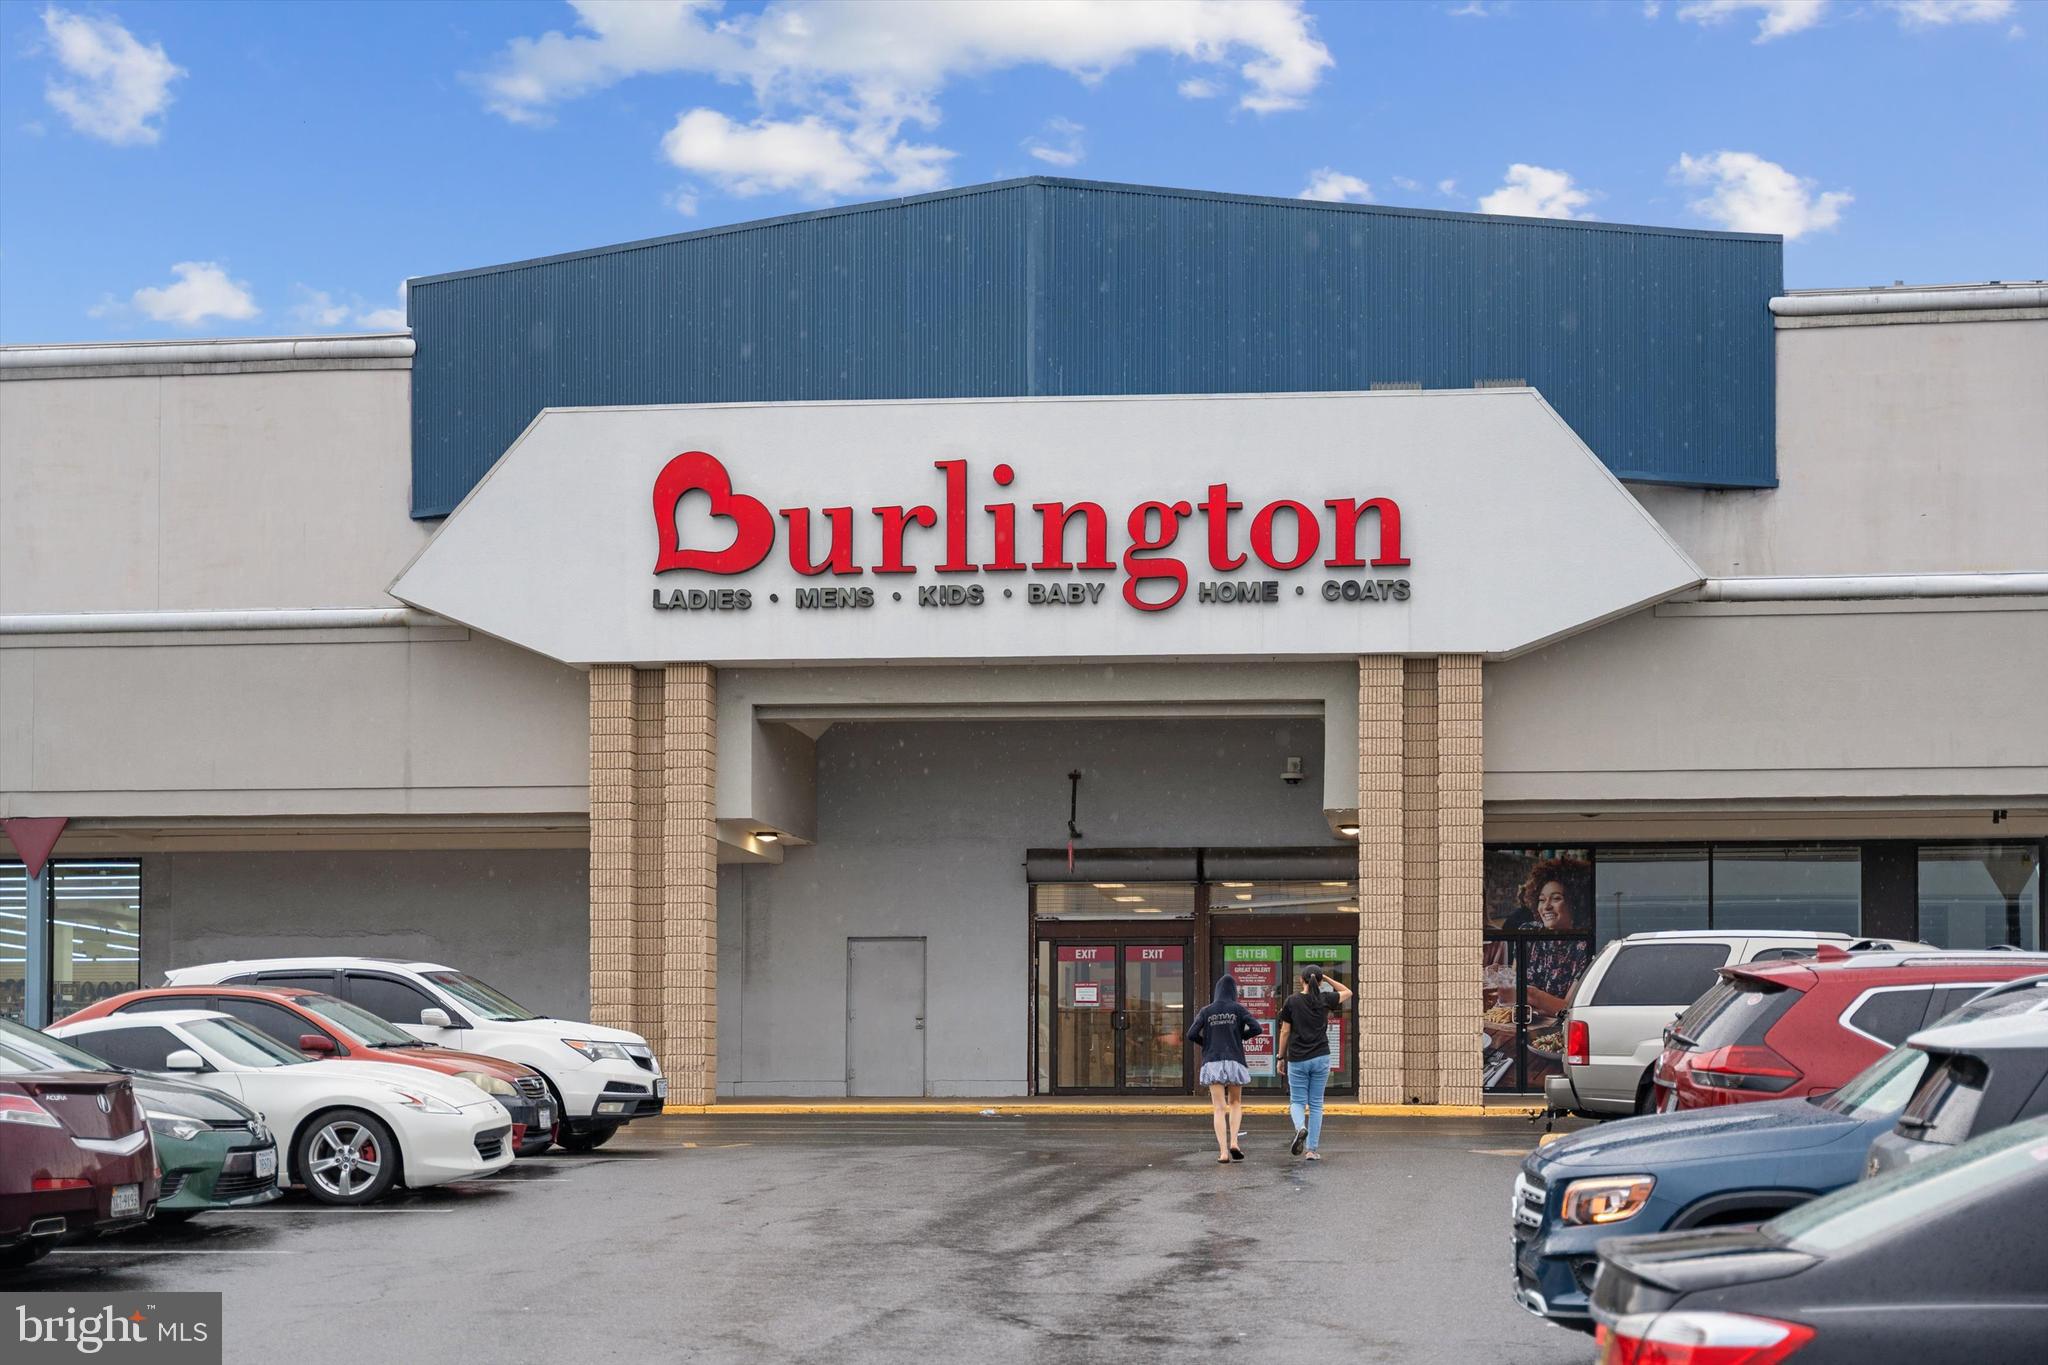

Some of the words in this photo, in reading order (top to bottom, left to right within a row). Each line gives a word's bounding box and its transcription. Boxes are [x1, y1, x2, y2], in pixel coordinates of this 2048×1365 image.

[653, 451, 1411, 612] Burlington
[652, 588, 752, 610] LADIES
[795, 587, 874, 608] MENS
[918, 584, 985, 606] KIDS
[1027, 582, 1105, 604] BABY
[1199, 580, 1279, 602] HOME
[1321, 579, 1411, 601] COATS
[1075, 949, 1097, 959] EXIT
[1142, 949, 1164, 959] EXIT
[1236, 949, 1268, 958] ENTER
[1305, 949, 1337, 958] ENTER
